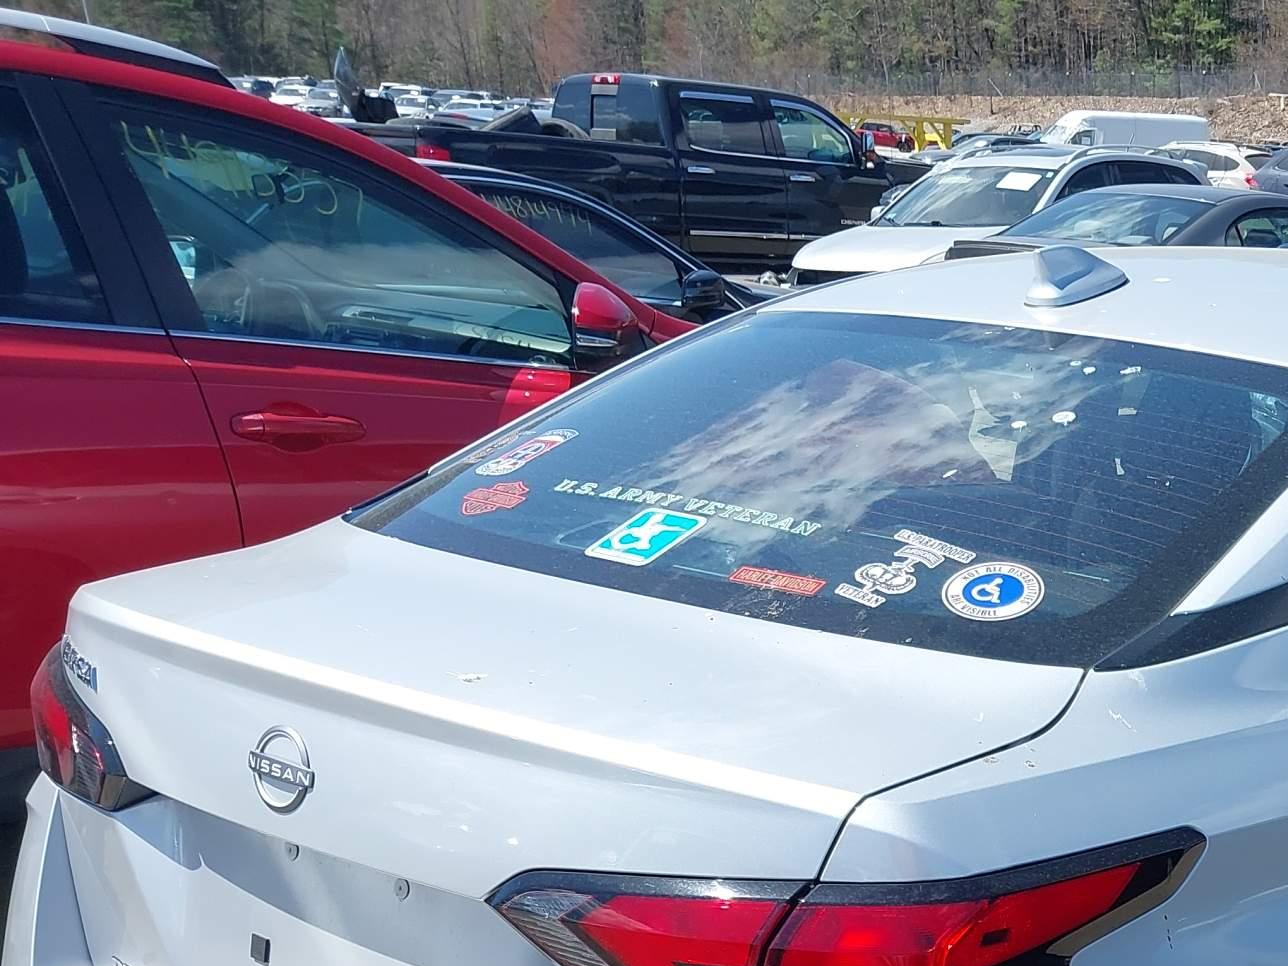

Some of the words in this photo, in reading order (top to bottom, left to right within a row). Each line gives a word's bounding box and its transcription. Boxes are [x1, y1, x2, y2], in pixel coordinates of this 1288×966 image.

[553, 478, 596, 497] U.S.
[599, 486, 684, 506] ARMY
[683, 497, 822, 537] VETERAN
[912, 534, 974, 562] PARATROOPER
[735, 568, 820, 593] HARLEY-DAVIDSON
[962, 569, 981, 581] NOT
[1007, 567, 1038, 606] DISABILITIES
[839, 585, 883, 606] VETERAN
[960, 603, 998, 618] VISIBLE
[249, 753, 311, 787] NISSAN
